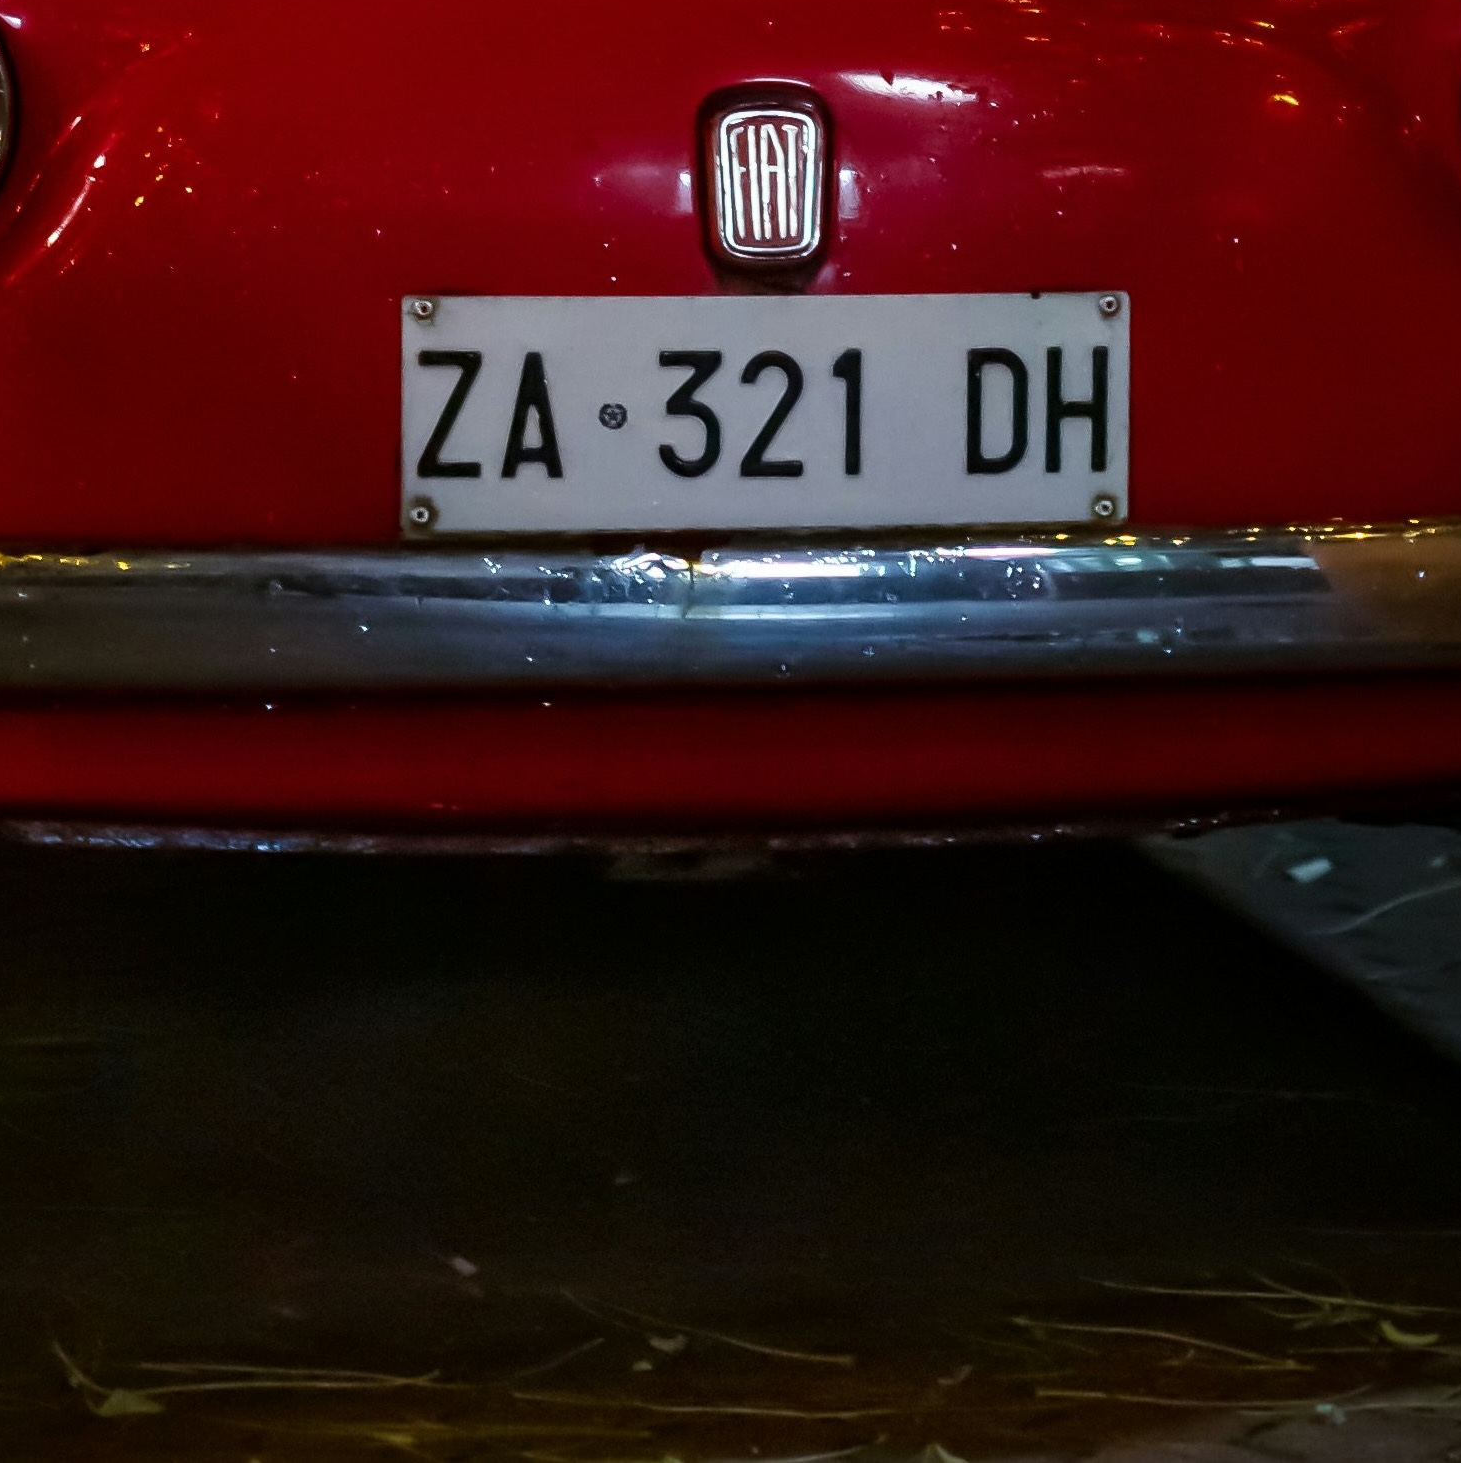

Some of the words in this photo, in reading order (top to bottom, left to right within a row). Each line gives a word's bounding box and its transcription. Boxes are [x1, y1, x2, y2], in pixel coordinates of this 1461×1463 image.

[729, 123, 799, 241] FIAT
[416, 349, 564, 479] ZA
[658, 347, 864, 478] 321
[966, 346, 1110, 475] DH
